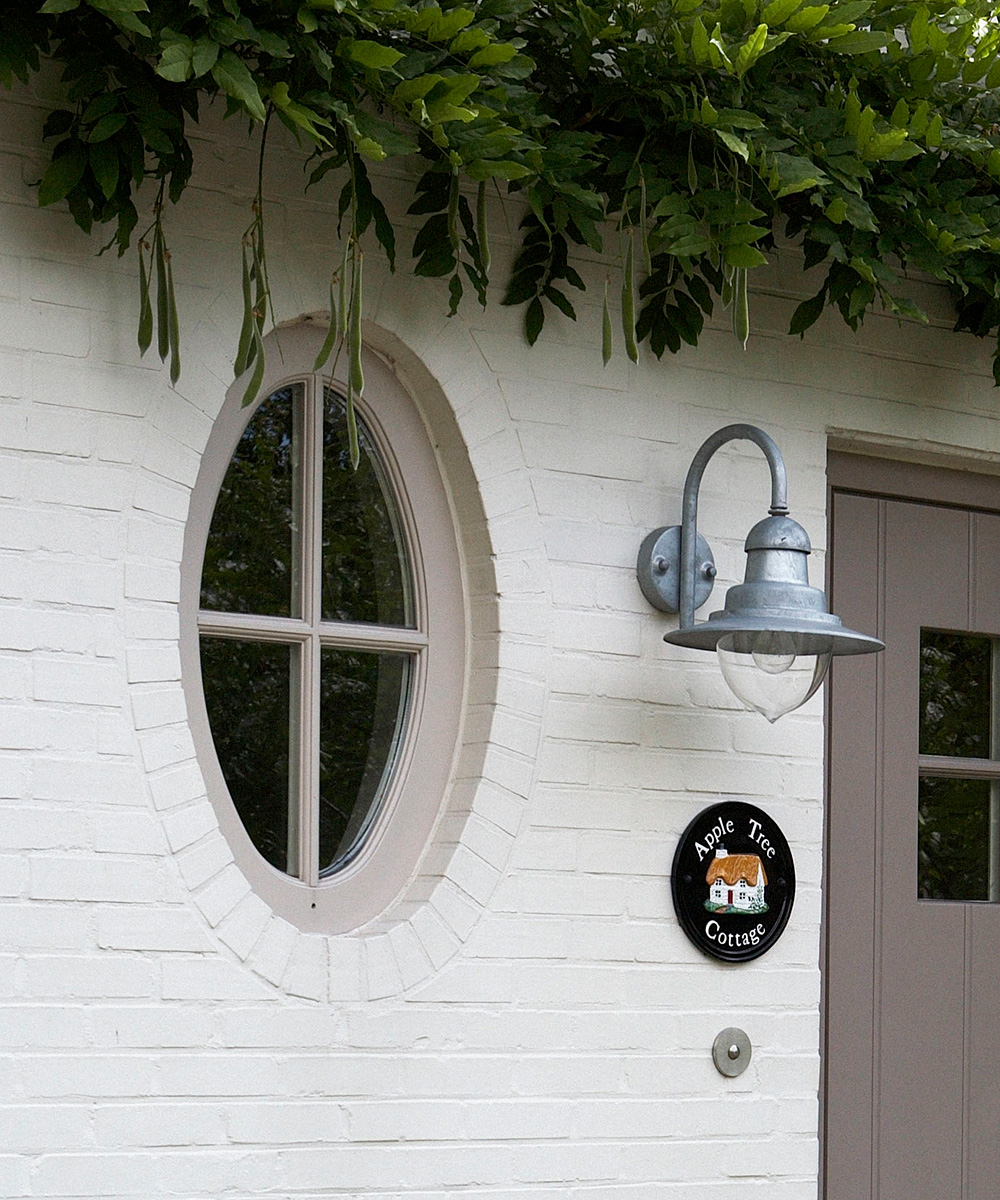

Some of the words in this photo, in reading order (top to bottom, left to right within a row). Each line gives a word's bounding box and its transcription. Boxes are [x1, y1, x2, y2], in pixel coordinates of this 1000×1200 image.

[694, 816, 735, 862] Apple
[748, 818, 776, 859] Tree
[705, 919, 766, 947] Cottage
